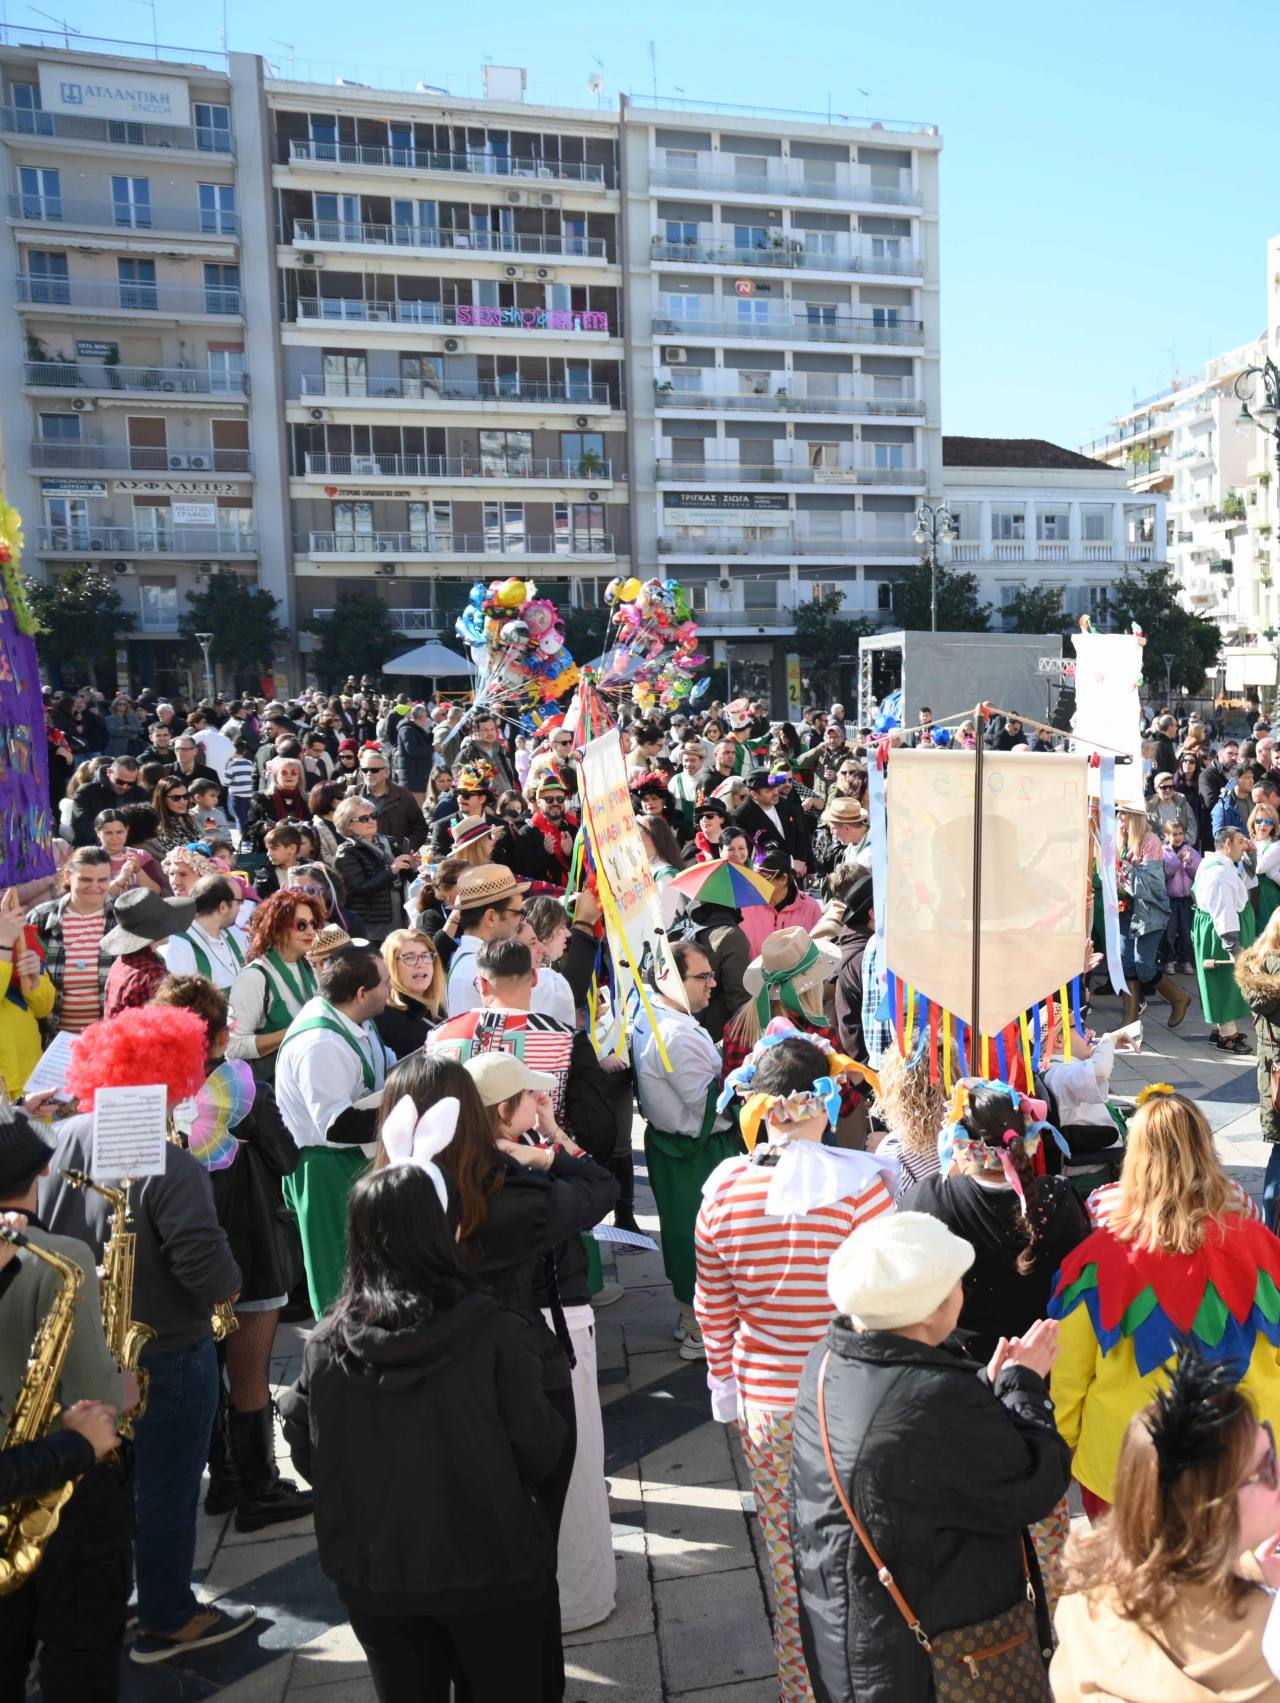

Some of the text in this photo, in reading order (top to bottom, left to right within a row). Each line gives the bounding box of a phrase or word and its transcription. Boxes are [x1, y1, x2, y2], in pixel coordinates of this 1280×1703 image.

[85, 84, 171, 104] ΑΤΛΑΝΤΙΚΗ
[116, 480, 233, 492] ΑΣΦΑΛΕΙΕΣ
[680, 494, 717, 502] ΤΡΙΓΚΑΣ
[723, 495, 750, 503] ΖΙΩΓΑ
